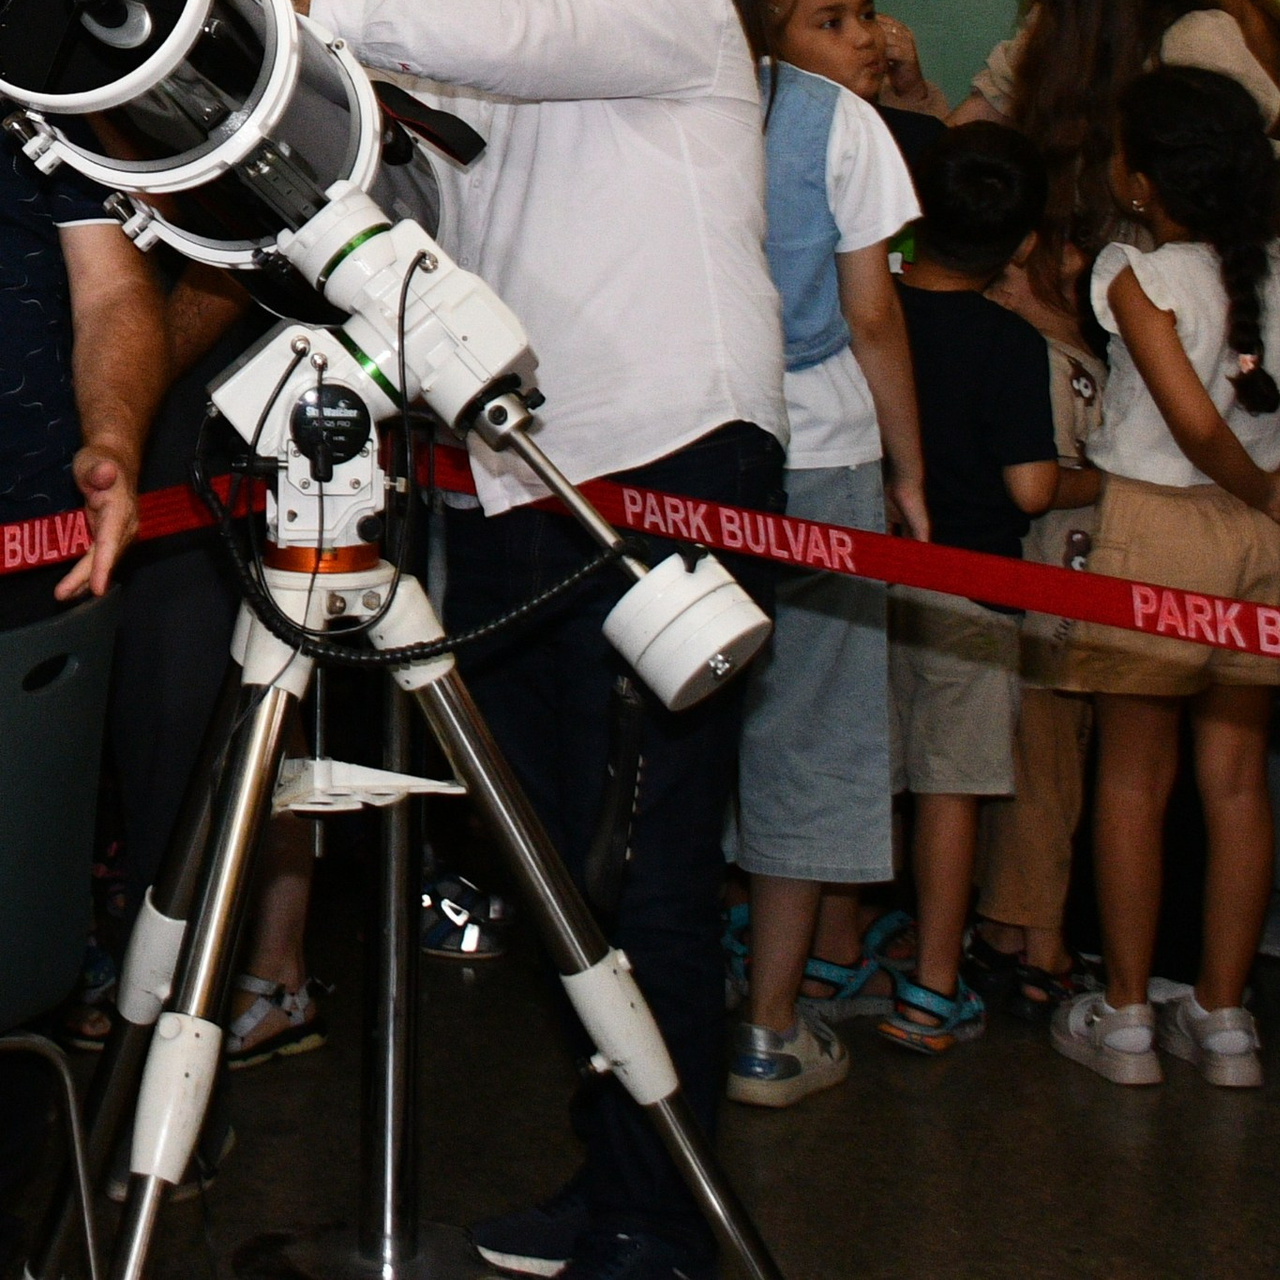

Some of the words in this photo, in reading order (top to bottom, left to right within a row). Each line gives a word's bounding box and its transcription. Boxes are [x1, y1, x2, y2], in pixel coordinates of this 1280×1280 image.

[4, 511, 92, 568] BULVA
[622, 488, 714, 543] PARK
[719, 507, 856, 572] BULVAR
[1131, 584, 1247, 648] PARK
[1256, 606, 1280, 654] B
